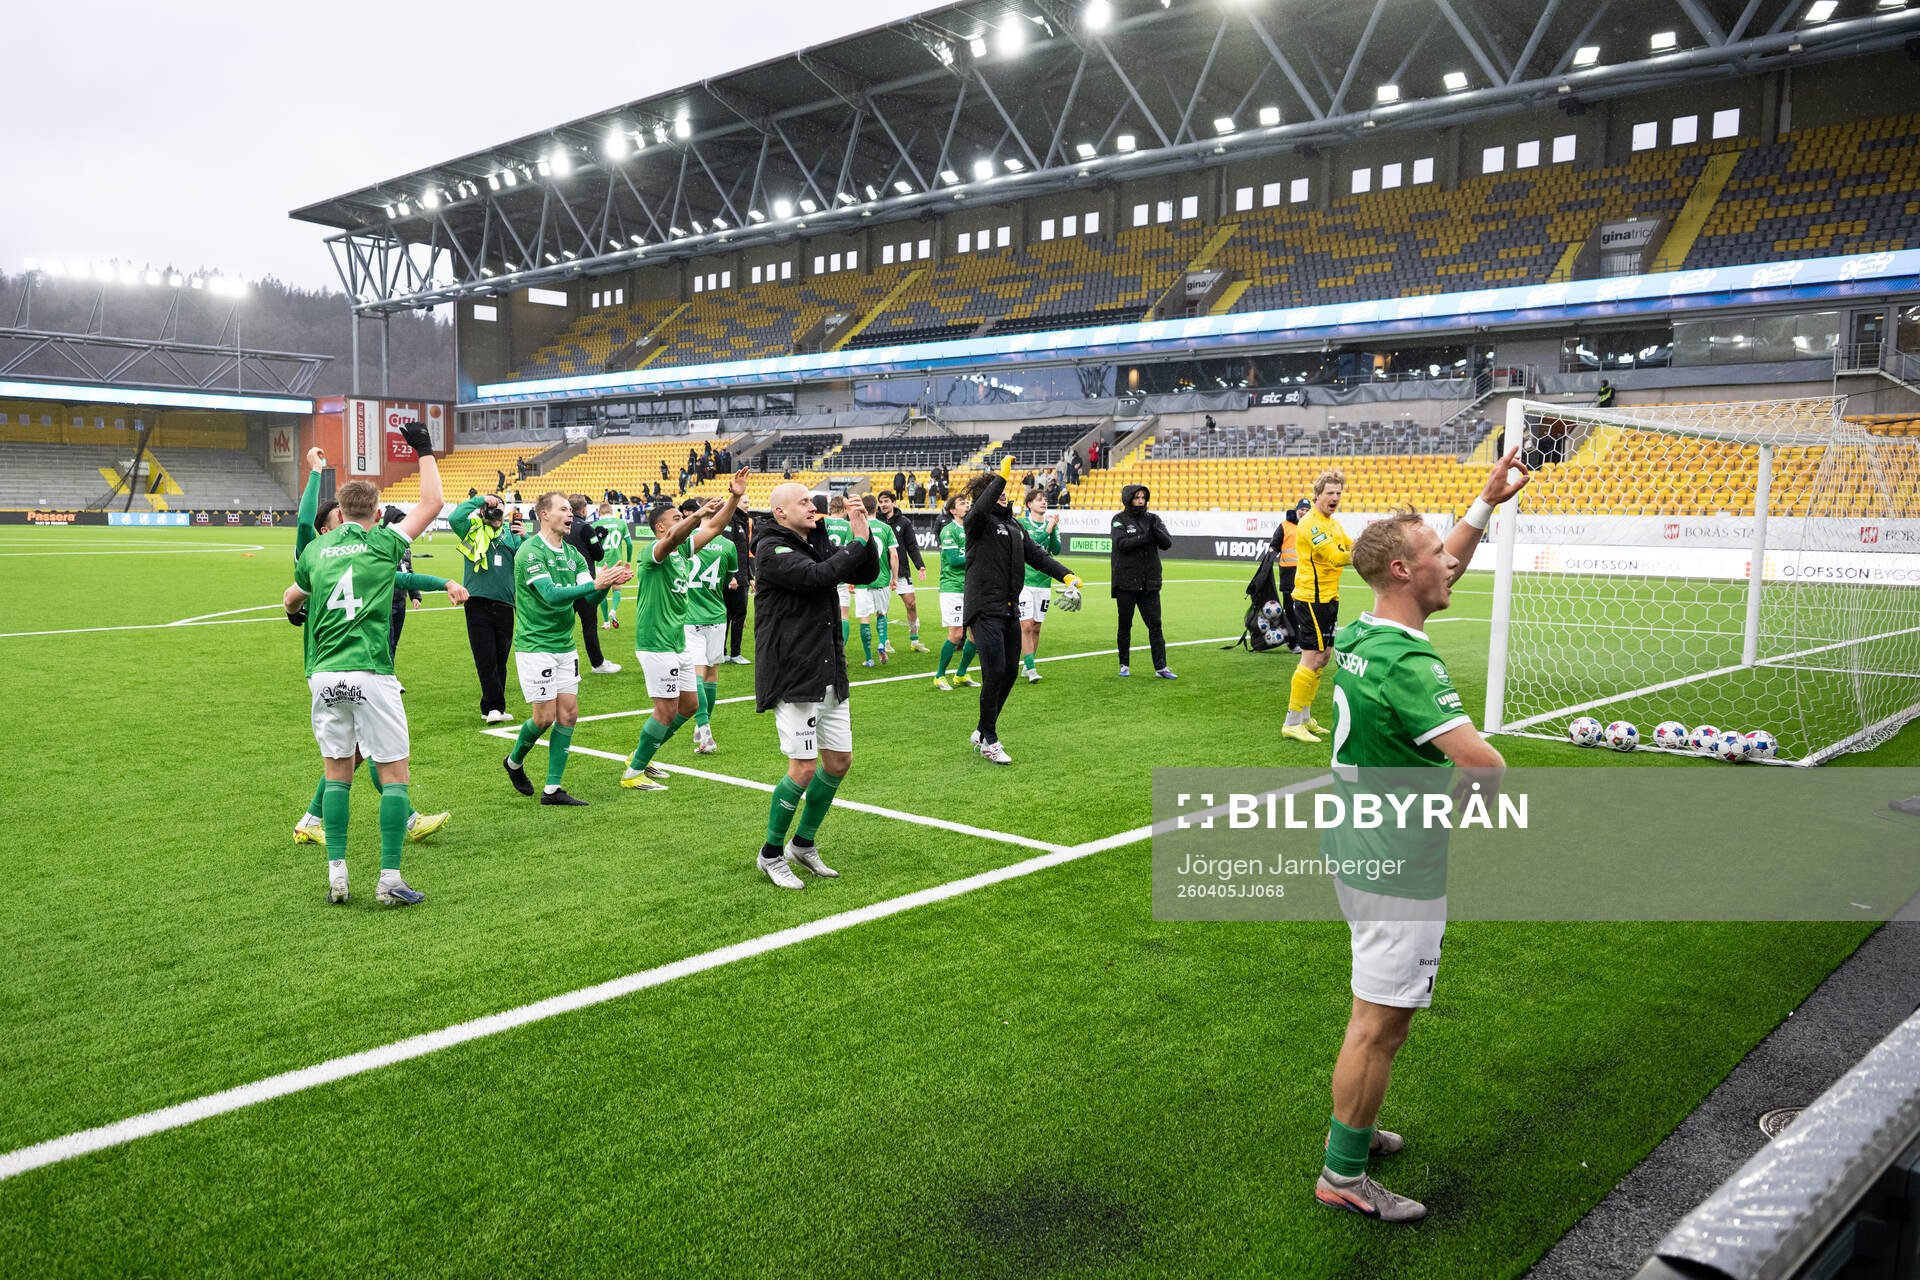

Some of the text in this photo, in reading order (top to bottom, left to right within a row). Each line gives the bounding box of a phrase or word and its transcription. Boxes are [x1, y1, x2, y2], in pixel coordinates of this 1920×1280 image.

[1261, 392, 1282, 403] stc
[392, 445, 412, 454] 7-23
[27, 512, 76, 521] Passera
[1685, 525, 1754, 538] BORÅS STA
[320, 543, 368, 559] PERSSON
[1072, 540, 1111, 551] UNIBET.SE
[1215, 541, 1227, 556] VI
[1566, 558, 1638, 571] OLOFSSON
[687, 554, 721, 590] 24
[1783, 565, 1869, 579] OLOFSSON
[327, 564, 363, 620] 4
[540, 687, 546, 696] 2
[666, 684, 676, 692] 28
[805, 740, 812, 750] 11
